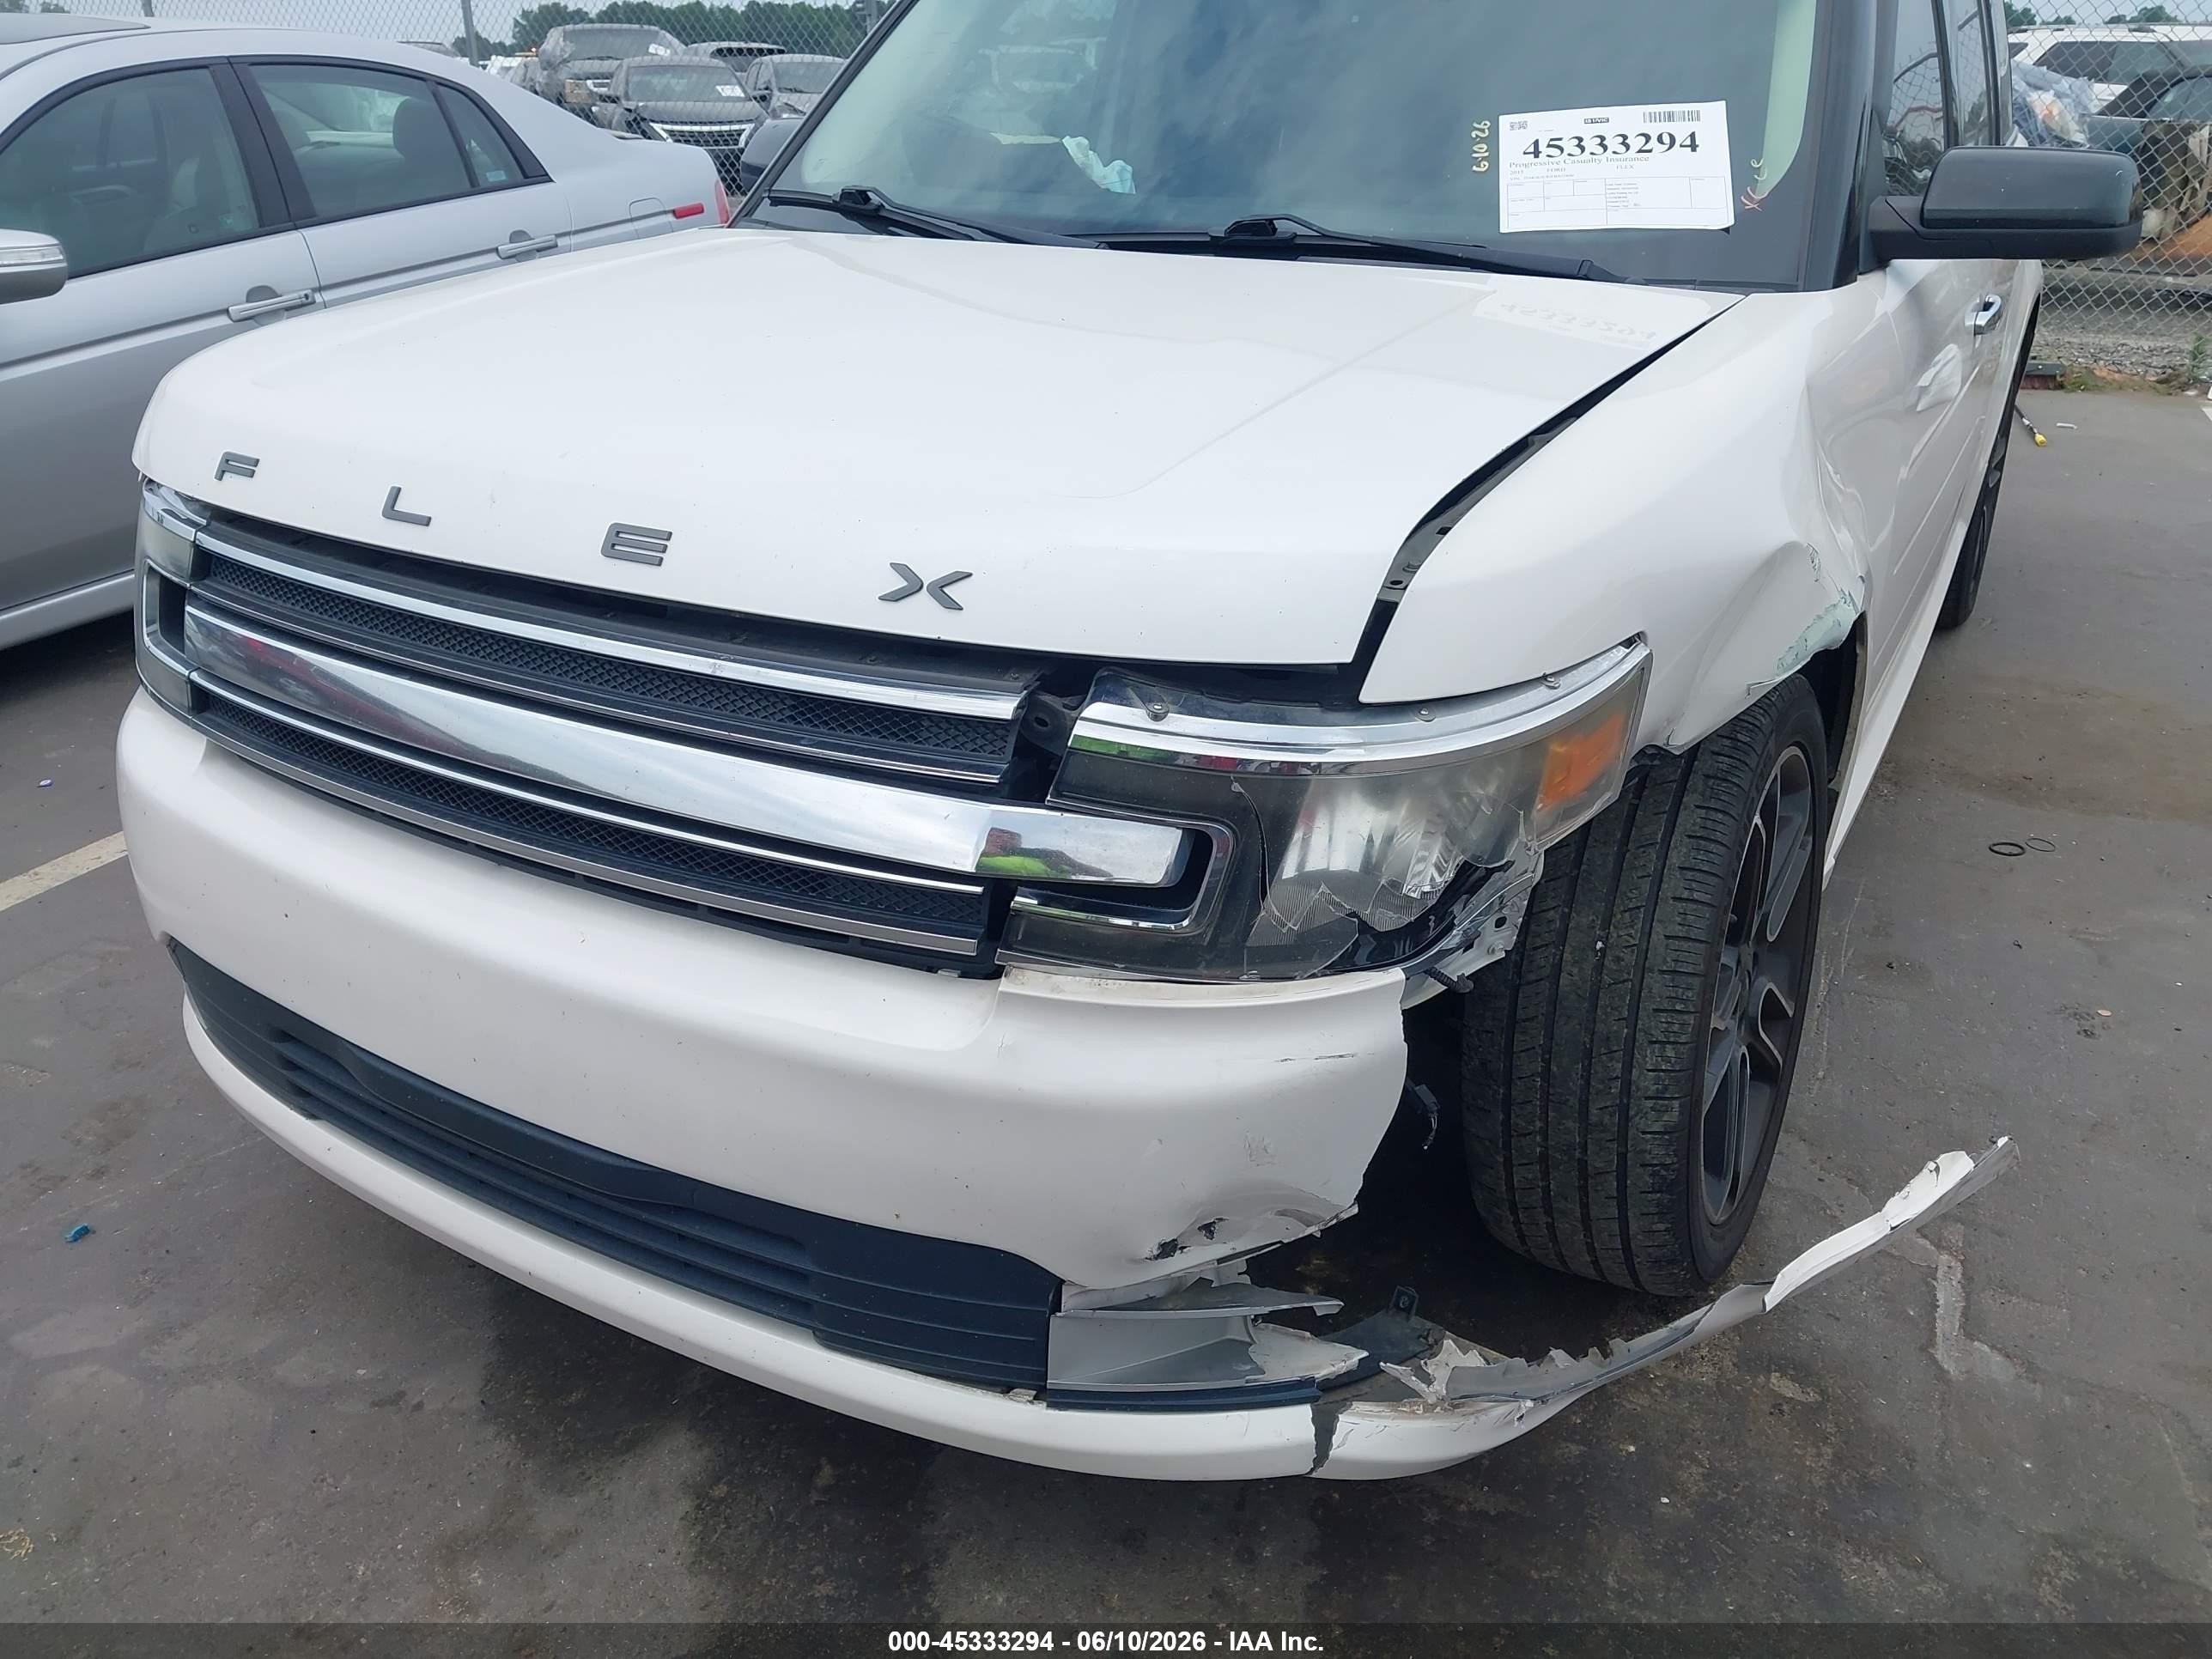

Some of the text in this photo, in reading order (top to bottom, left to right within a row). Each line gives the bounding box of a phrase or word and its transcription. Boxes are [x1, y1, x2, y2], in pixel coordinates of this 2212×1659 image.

[1522, 131, 1699, 159] 45333294
[1509, 160, 1561, 169] Progressive
[1563, 157, 1602, 166] Casualty
[215, 451, 973, 611] FLEX
